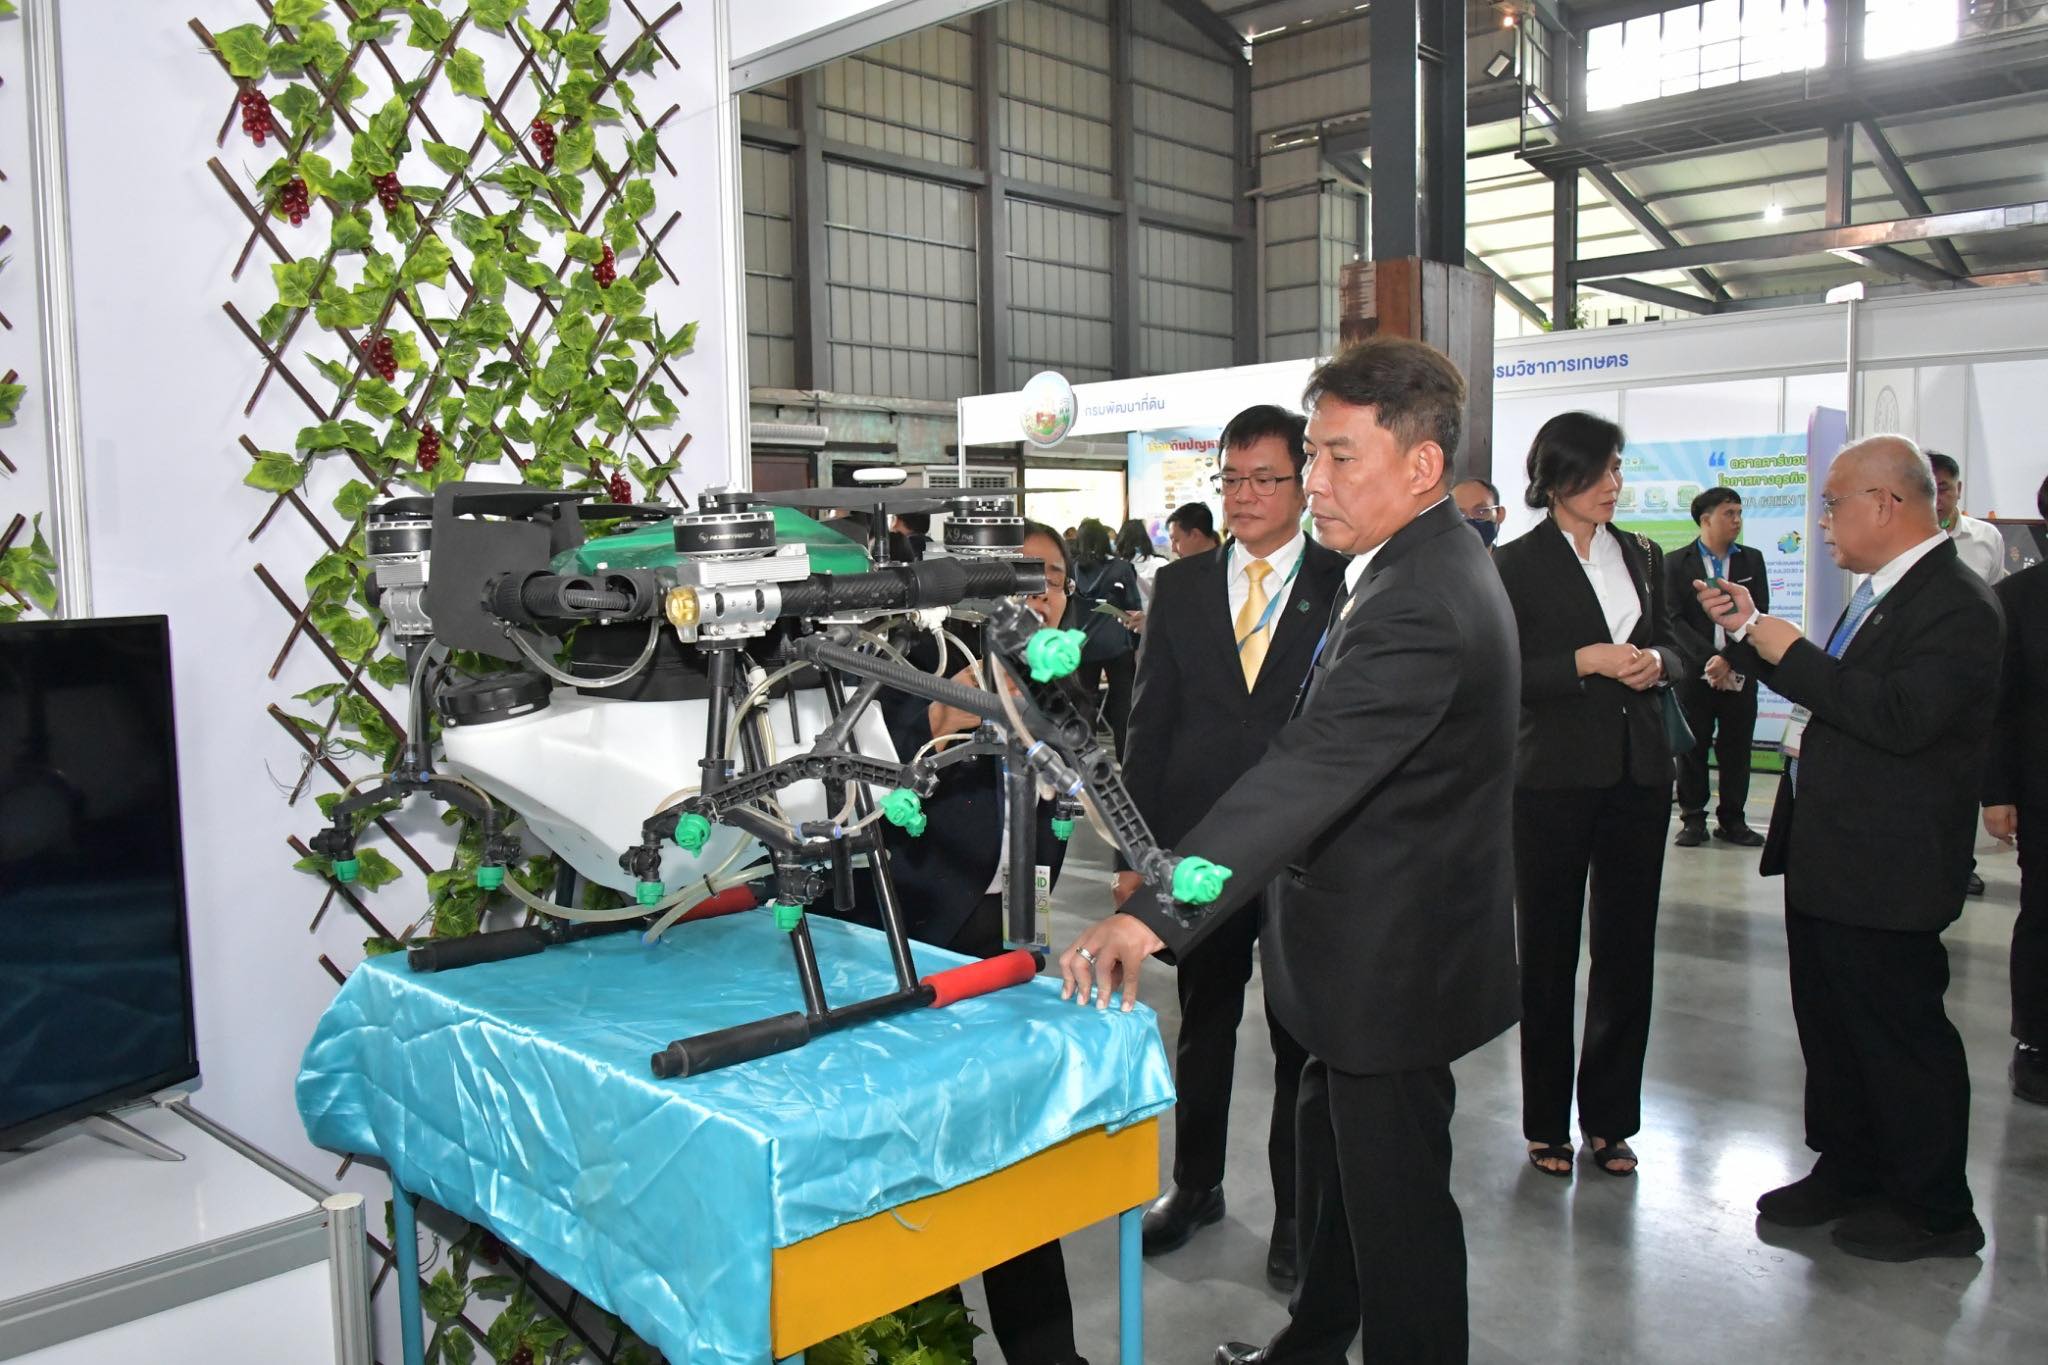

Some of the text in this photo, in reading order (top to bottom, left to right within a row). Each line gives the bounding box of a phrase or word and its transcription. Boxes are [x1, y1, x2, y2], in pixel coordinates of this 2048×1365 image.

[1493, 353, 1629, 378] รมวิชาการเกษตร
